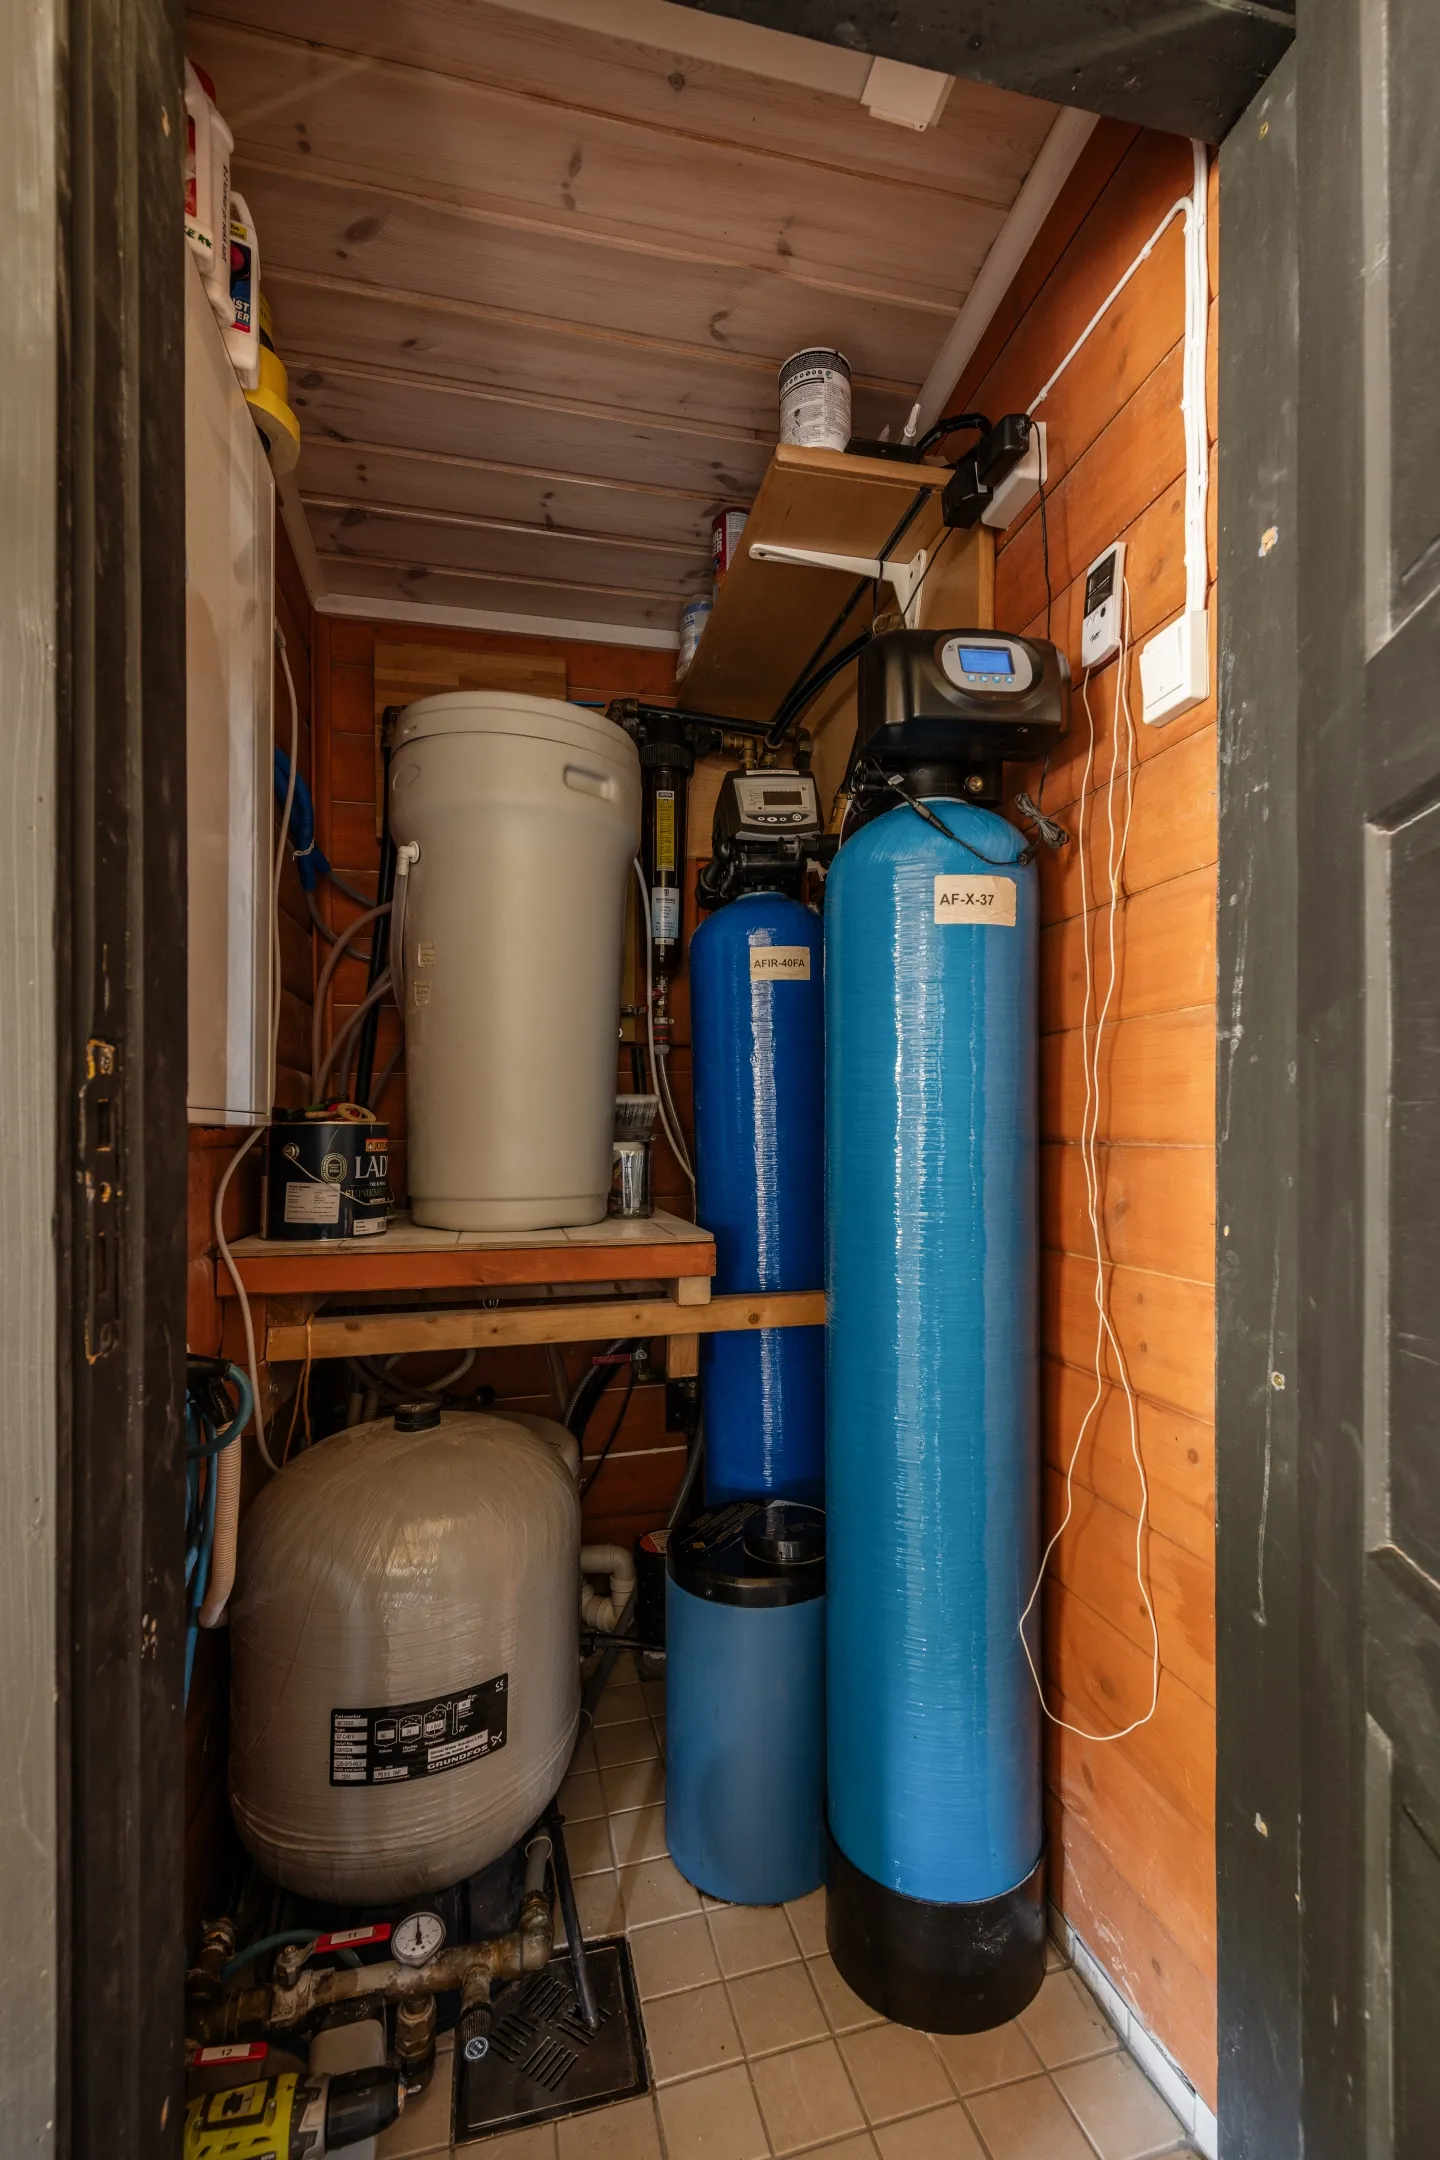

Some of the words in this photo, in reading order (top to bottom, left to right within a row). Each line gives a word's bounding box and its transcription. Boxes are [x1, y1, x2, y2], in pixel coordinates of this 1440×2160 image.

[939, 893, 995, 906] AF-X-37
[754, 958, 806, 969] AFIR-40FA
[355, 1155, 388, 1179] LAD
[427, 1744, 488, 1769] GRUNDFOS
[220, 2048, 233, 2057] 12
